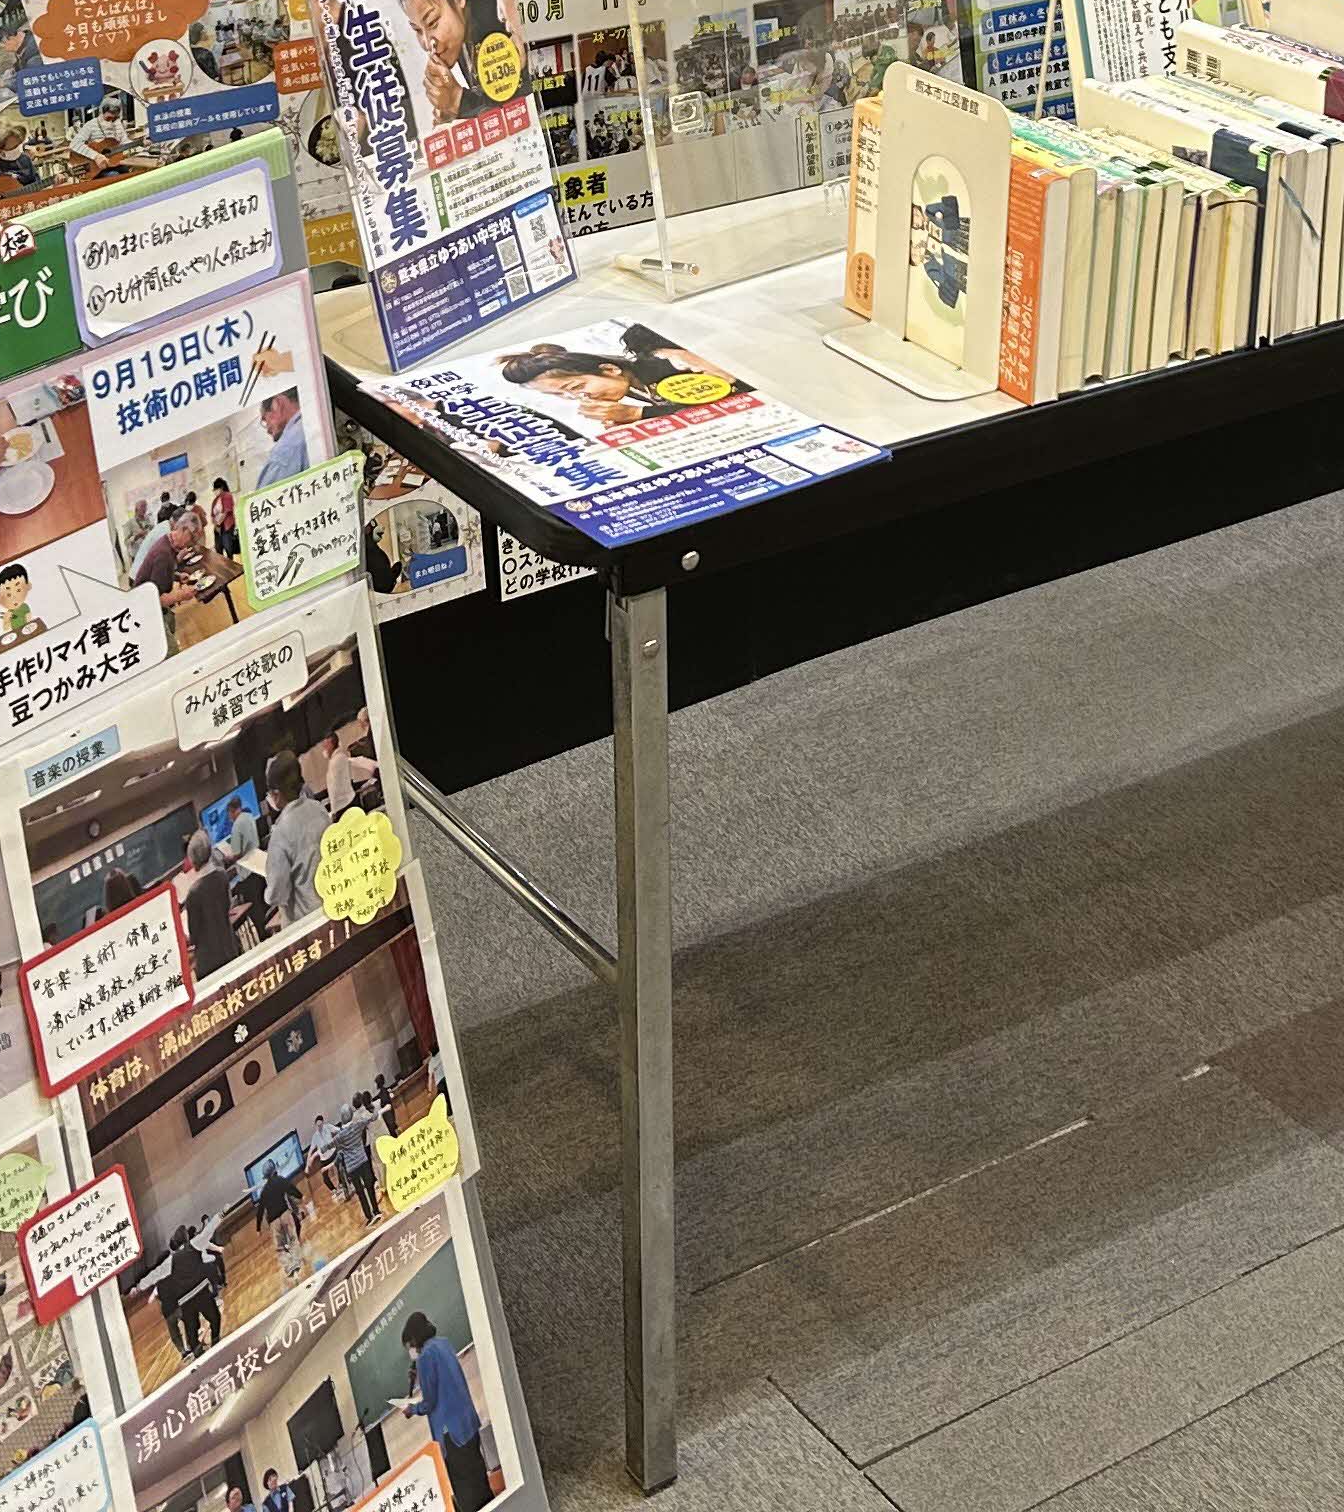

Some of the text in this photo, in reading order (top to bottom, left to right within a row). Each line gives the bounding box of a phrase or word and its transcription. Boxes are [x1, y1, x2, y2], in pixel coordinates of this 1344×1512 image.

[340, 3, 430, 254] 生徒募集
[90, 309, 255, 401] 9月19日(木)
[115, 355, 246, 437] 技術の時間
[9, 641, 142, 729] 豆つかみ大会
[183, 644, 295, 715] みんなで校歌の
[210, 679, 273, 728] 練習です
[30, 738, 107, 791] 音楽の授業
[132, 1210, 448, 1466] 湧心館高校との合同防犯教室
